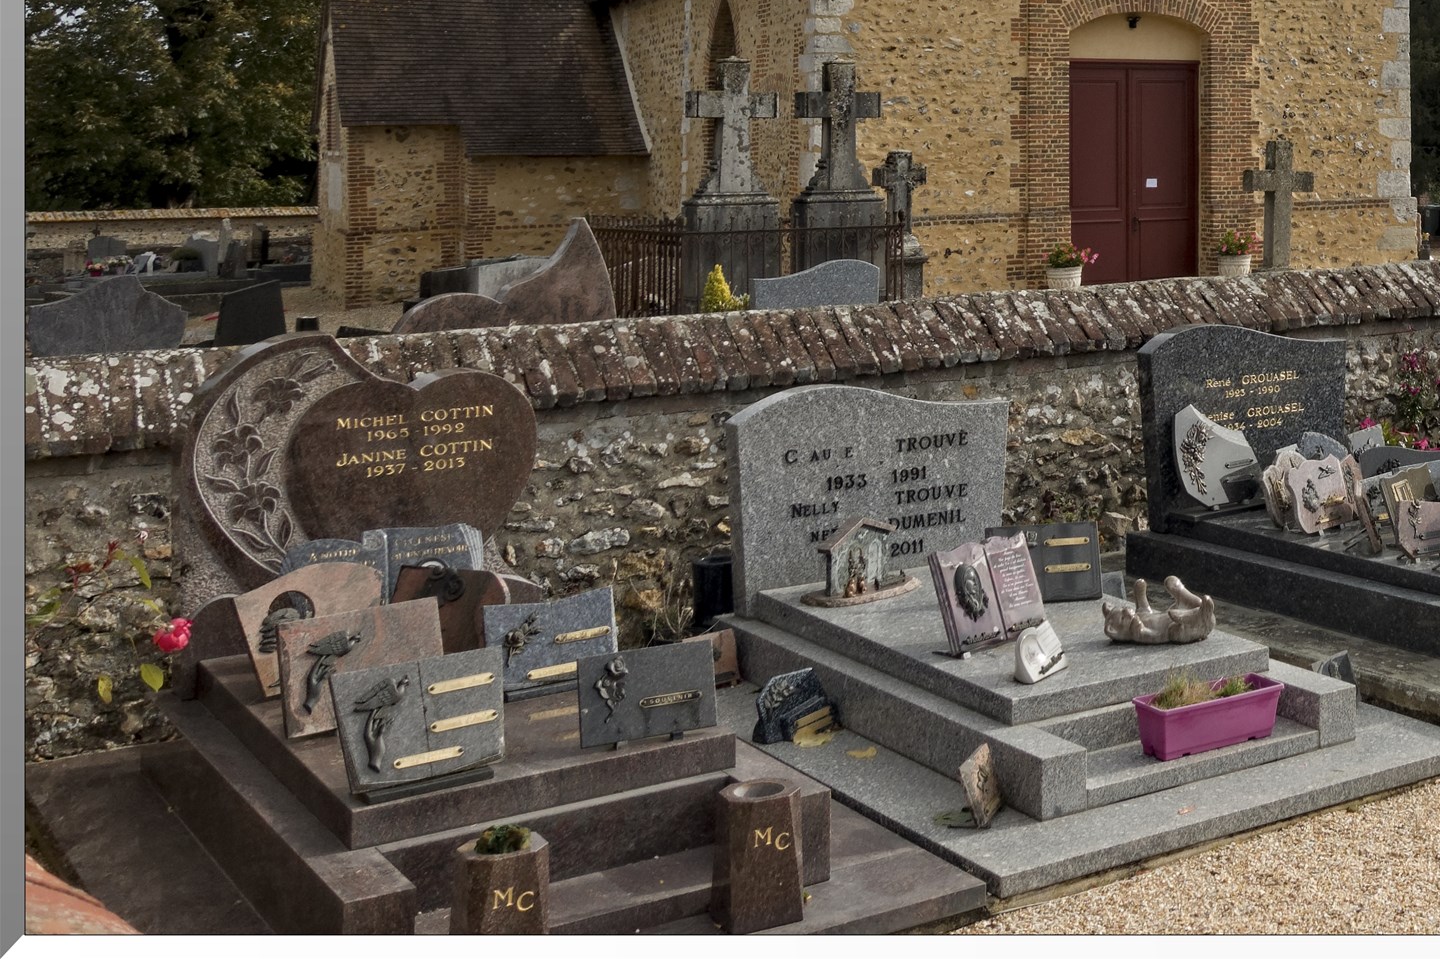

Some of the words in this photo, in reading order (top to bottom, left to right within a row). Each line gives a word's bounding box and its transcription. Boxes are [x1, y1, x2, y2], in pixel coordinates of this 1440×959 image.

[1241, 370, 1300, 386] GROUASEL
[1257, 384, 1281, 396] 1990
[336, 414, 408, 431] MICHEL
[420, 404, 494, 422] COTTIN
[1246, 402, 1305, 418] GROUASEL
[367, 427, 410, 442] 1965
[423, 422, 465, 436] 1992
[1256, 417, 1283, 429] 2004
[336, 449, 408, 467] JANINE
[419, 438, 494, 457] COTTIN
[366, 462, 407, 479] 1937
[423, 456, 466, 472] 2013
[825, 473, 868, 491] 1933
[891, 465, 928, 484] 1991
[790, 500, 840, 519] NELLY
[890, 539, 925, 558] 2011
[753, 825, 791, 852] MC
[491, 885, 535, 914] MC
